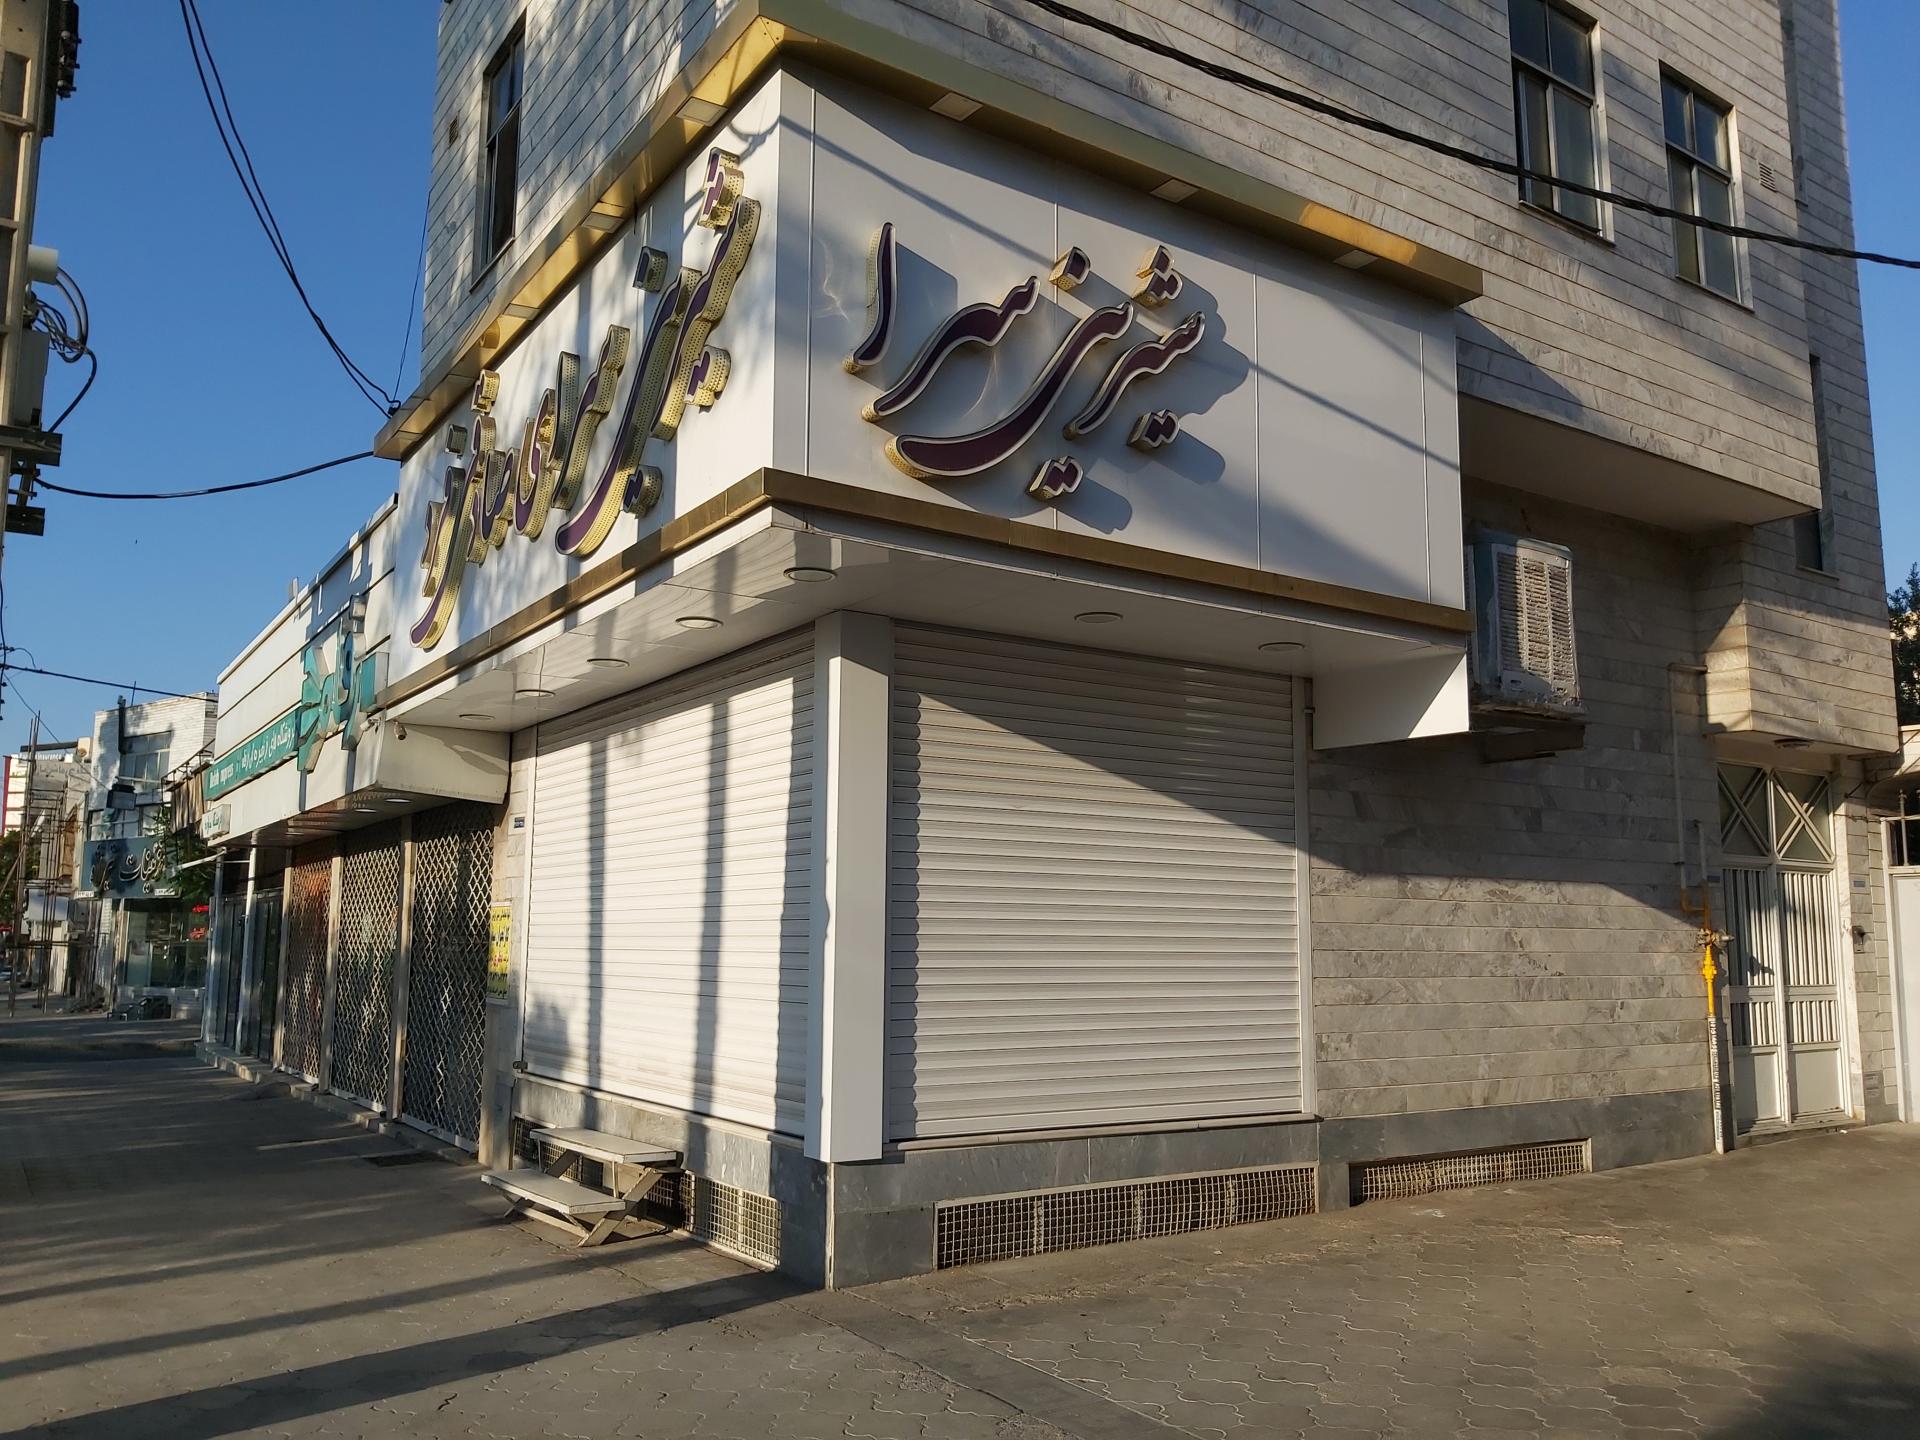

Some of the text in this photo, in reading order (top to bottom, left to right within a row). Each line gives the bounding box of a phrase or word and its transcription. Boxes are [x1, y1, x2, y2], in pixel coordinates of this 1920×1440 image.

[513, 324, 630, 540] سرای
[555, 147, 761, 557] شیرینی
[842, 221, 1206, 501] شیرینی سرا
